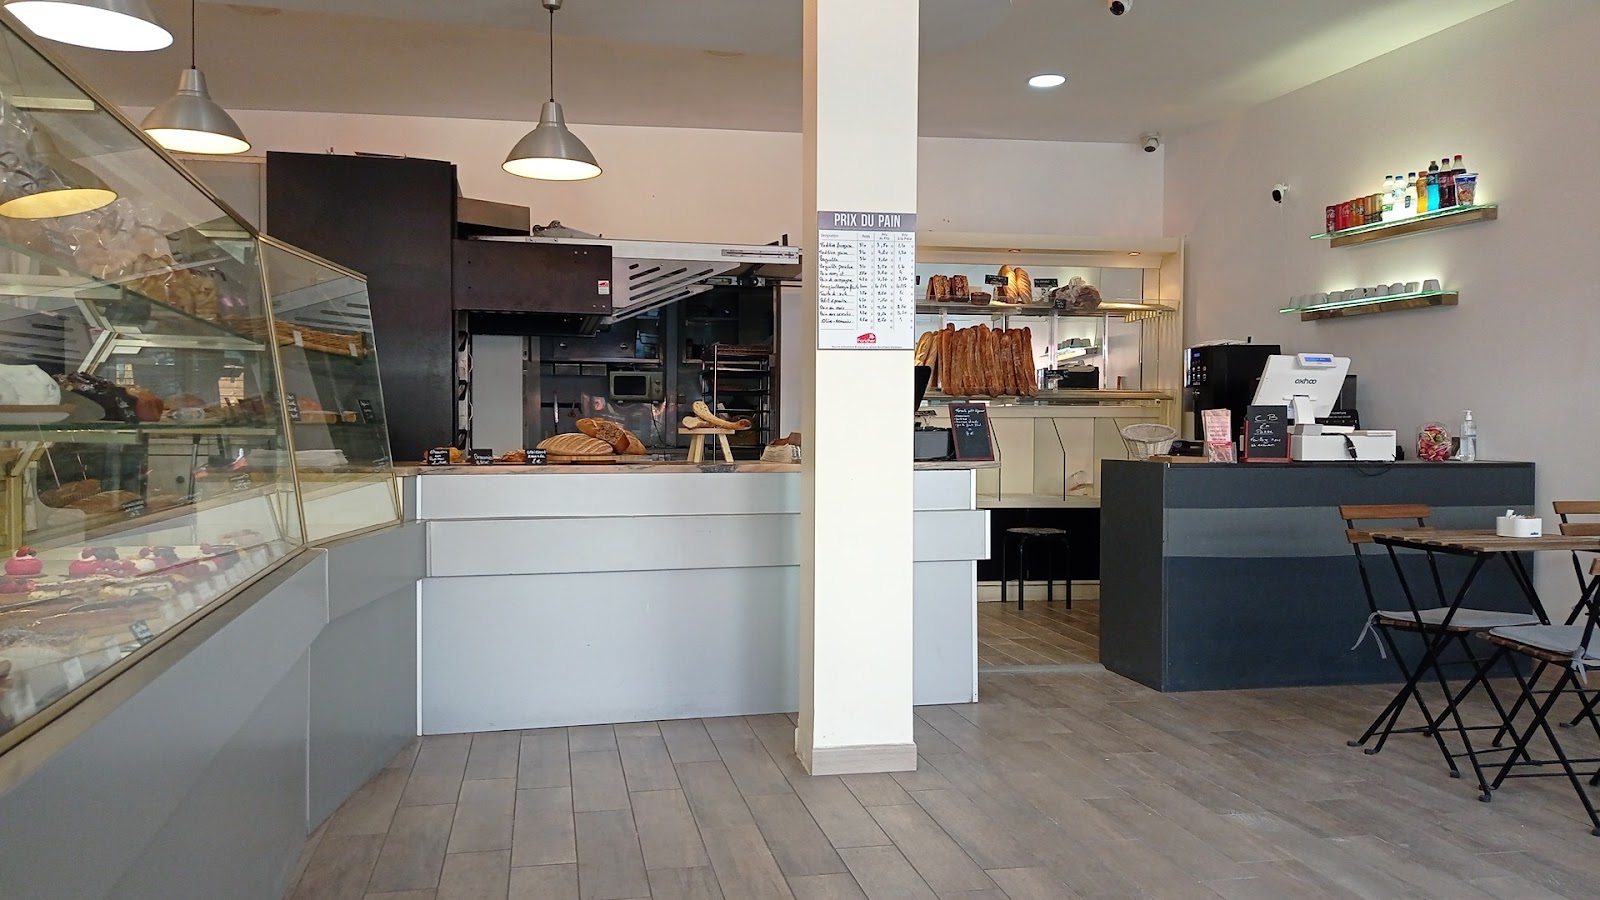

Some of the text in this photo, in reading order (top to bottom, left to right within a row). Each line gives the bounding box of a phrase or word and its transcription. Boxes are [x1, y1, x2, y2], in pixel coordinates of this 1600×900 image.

[834, 213, 901, 228] PRIX DU PAIN
